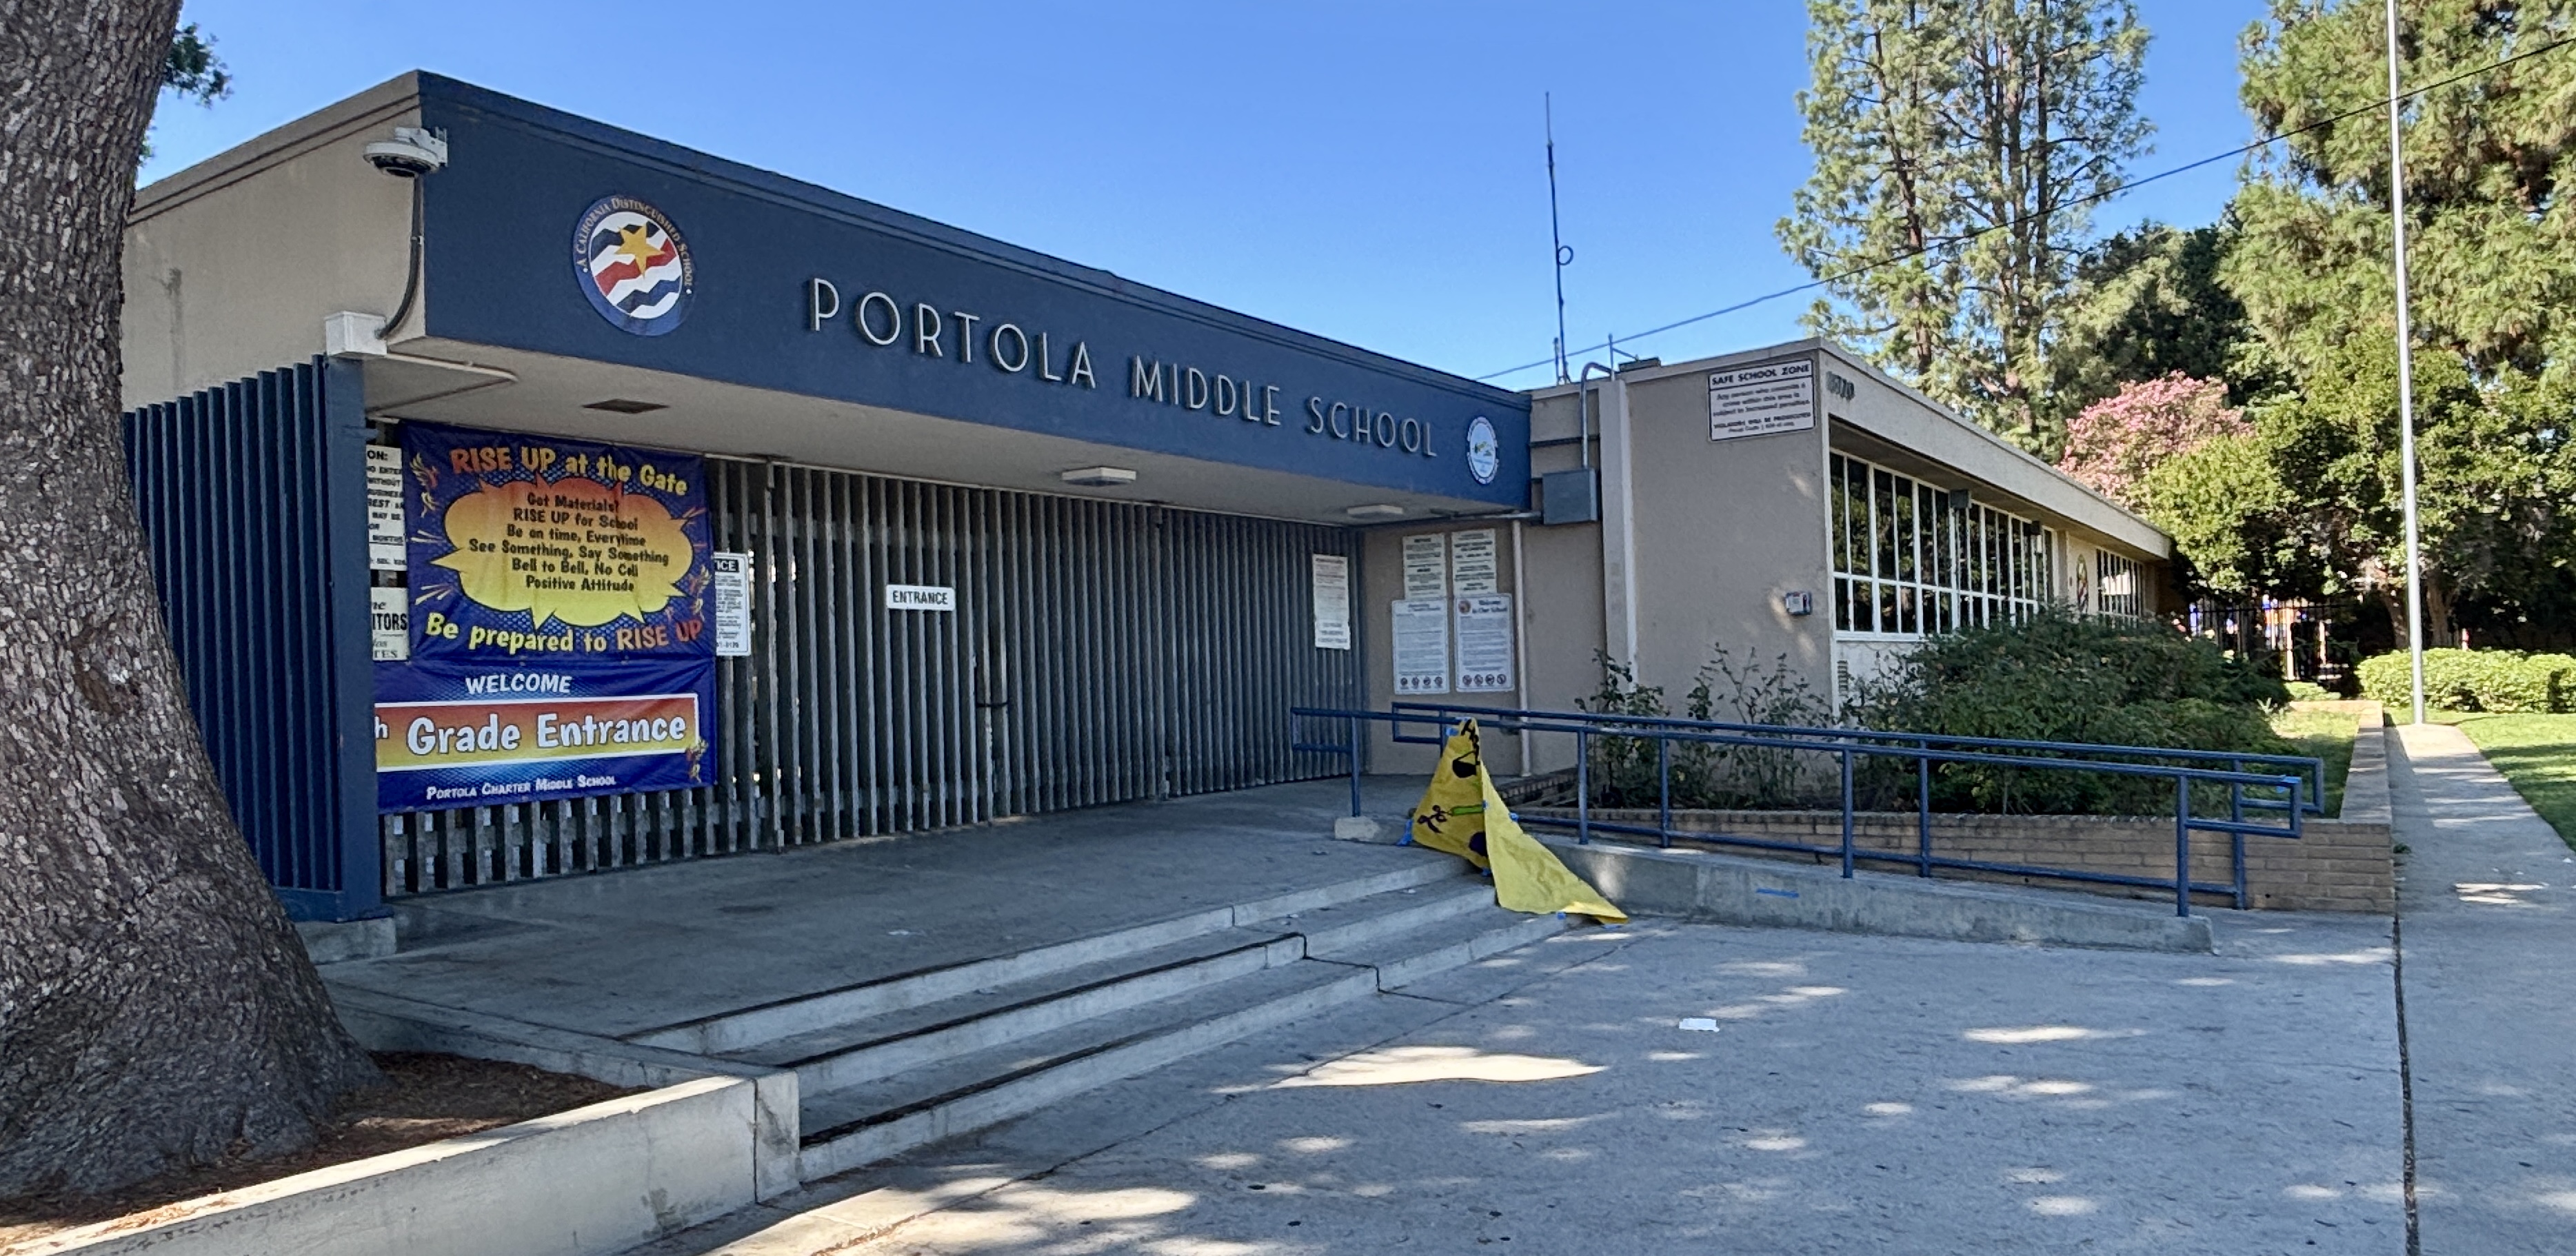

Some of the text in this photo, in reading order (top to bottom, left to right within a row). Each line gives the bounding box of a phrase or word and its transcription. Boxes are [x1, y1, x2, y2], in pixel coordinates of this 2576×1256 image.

[576, 203, 611, 253] CALIFORNIA
[612, 198, 681, 241] DISTINGUISHED
[678, 244, 692, 286] SCHOOL
[807, 277, 1436, 458] PORTOLA MIDDLE SCHOOL
[1712, 364, 1810, 385] SAFE SCHOOL ZONE
[367, 450, 388, 460] ON:
[450, 446, 687, 496] RISE UP at the Gate
[527, 492, 618, 512] Got Materials?
[514, 507, 638, 530] RISE UP for School
[507, 524, 646, 547] Be on time, Everytime
[469, 538, 669, 566] See Something, Say Something
[512, 557, 638, 577] Bell to Bell, No Cell
[526, 575, 634, 591] Positive Attitude
[892, 590, 948, 605] ENTRANCE
[425, 612, 459, 639] Be
[469, 626, 574, 654] prepared
[584, 632, 607, 652] to
[617, 625, 669, 650] RISE
[676, 619, 703, 642] UP
[465, 673, 572, 694] WELCOME
[407, 713, 521, 755] Grade
[537, 713, 686, 748] Entrance
[427, 774, 616, 800] PORTOLA CHARTER MIDDLE SCHOOL
